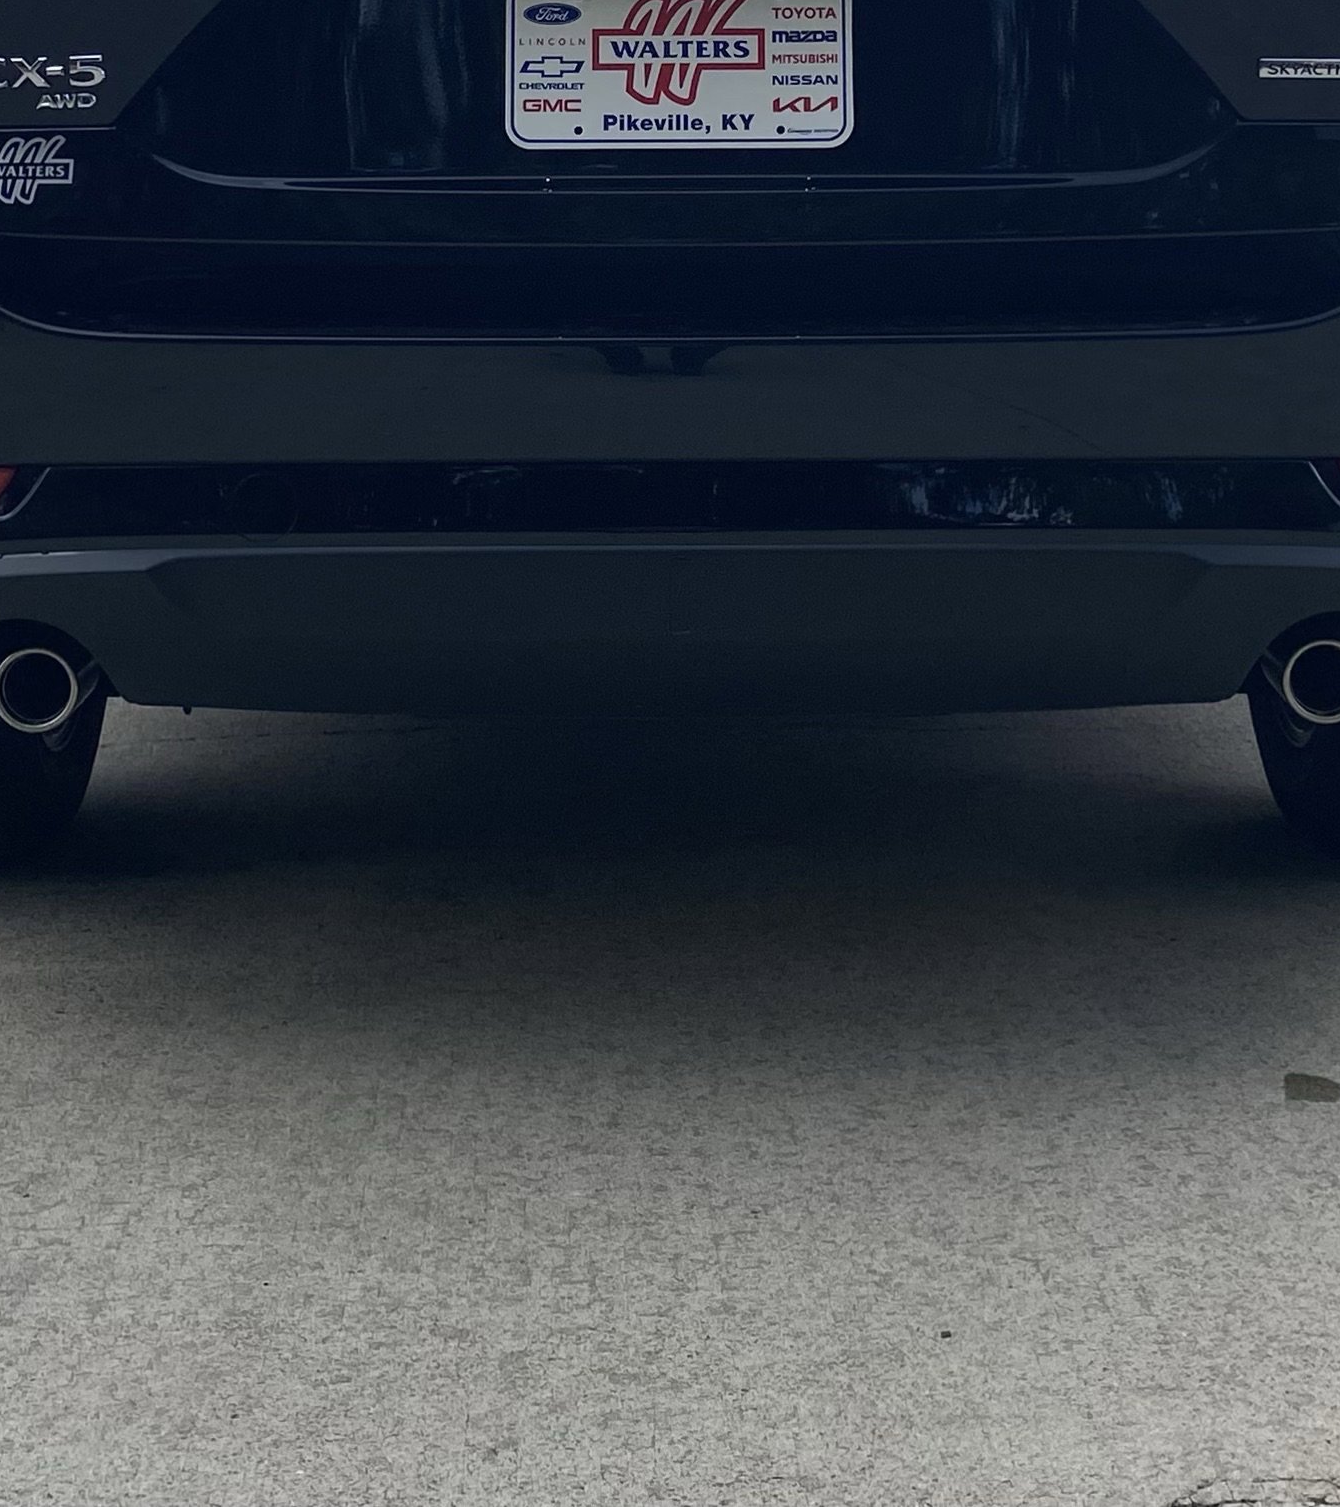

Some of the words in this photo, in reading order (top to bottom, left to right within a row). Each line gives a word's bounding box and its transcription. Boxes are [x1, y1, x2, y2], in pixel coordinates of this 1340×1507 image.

[535, 7, 569, 21] Ford
[771, 6, 837, 20] TOYOTA
[518, 37, 587, 46] LINCOLN
[610, 40, 751, 59] WALTERS
[771, 53, 838, 64] MITSUBISHI
[518, 82, 586, 90] CHEVROLET
[771, 75, 838, 86] NISSAN
[36, 93, 98, 110] AWD
[522, 98, 582, 113] GMC
[772, 96, 838, 113] KIA
[602, 114, 711, 133] Pikeville,
[721, 114, 756, 131] KY
